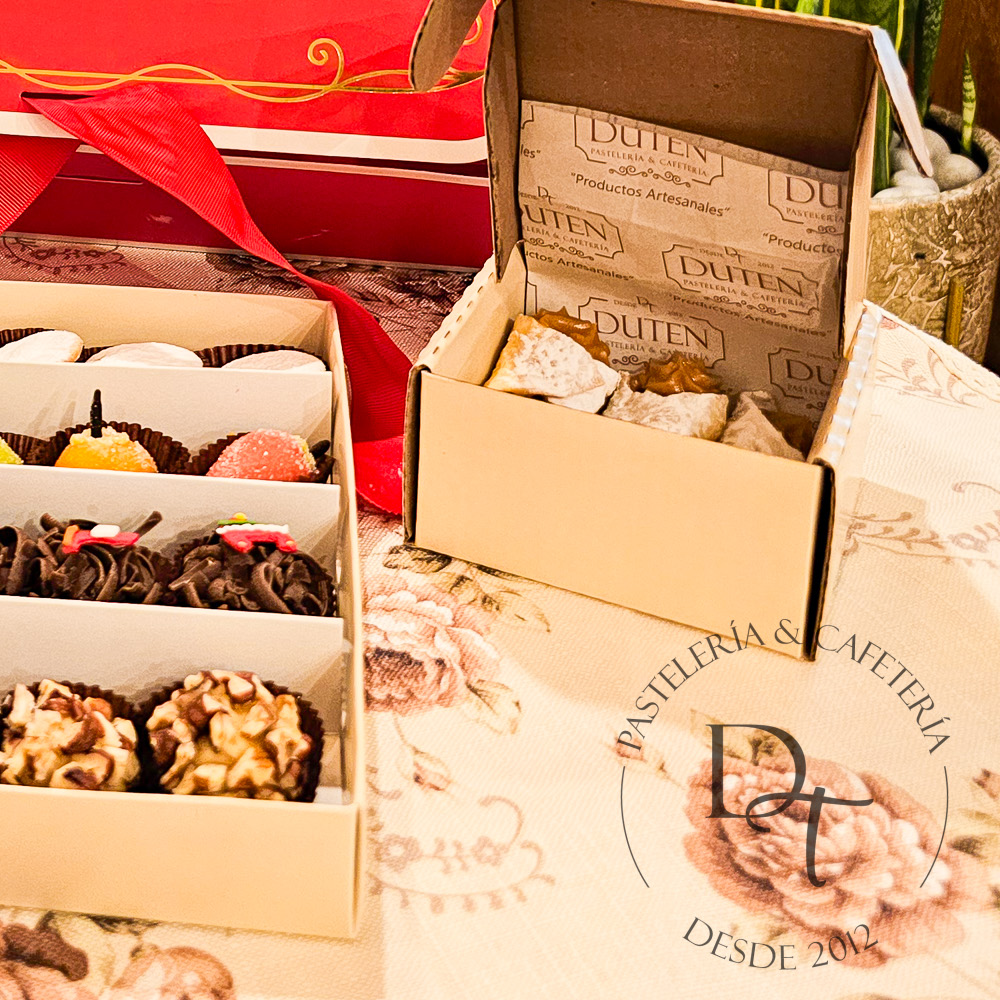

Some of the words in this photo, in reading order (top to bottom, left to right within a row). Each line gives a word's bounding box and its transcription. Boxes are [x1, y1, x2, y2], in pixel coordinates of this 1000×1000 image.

[523, 204, 608, 241] UTEN
[678, 255, 804, 298] DUTEN
[594, 310, 709, 350] DUTEN
